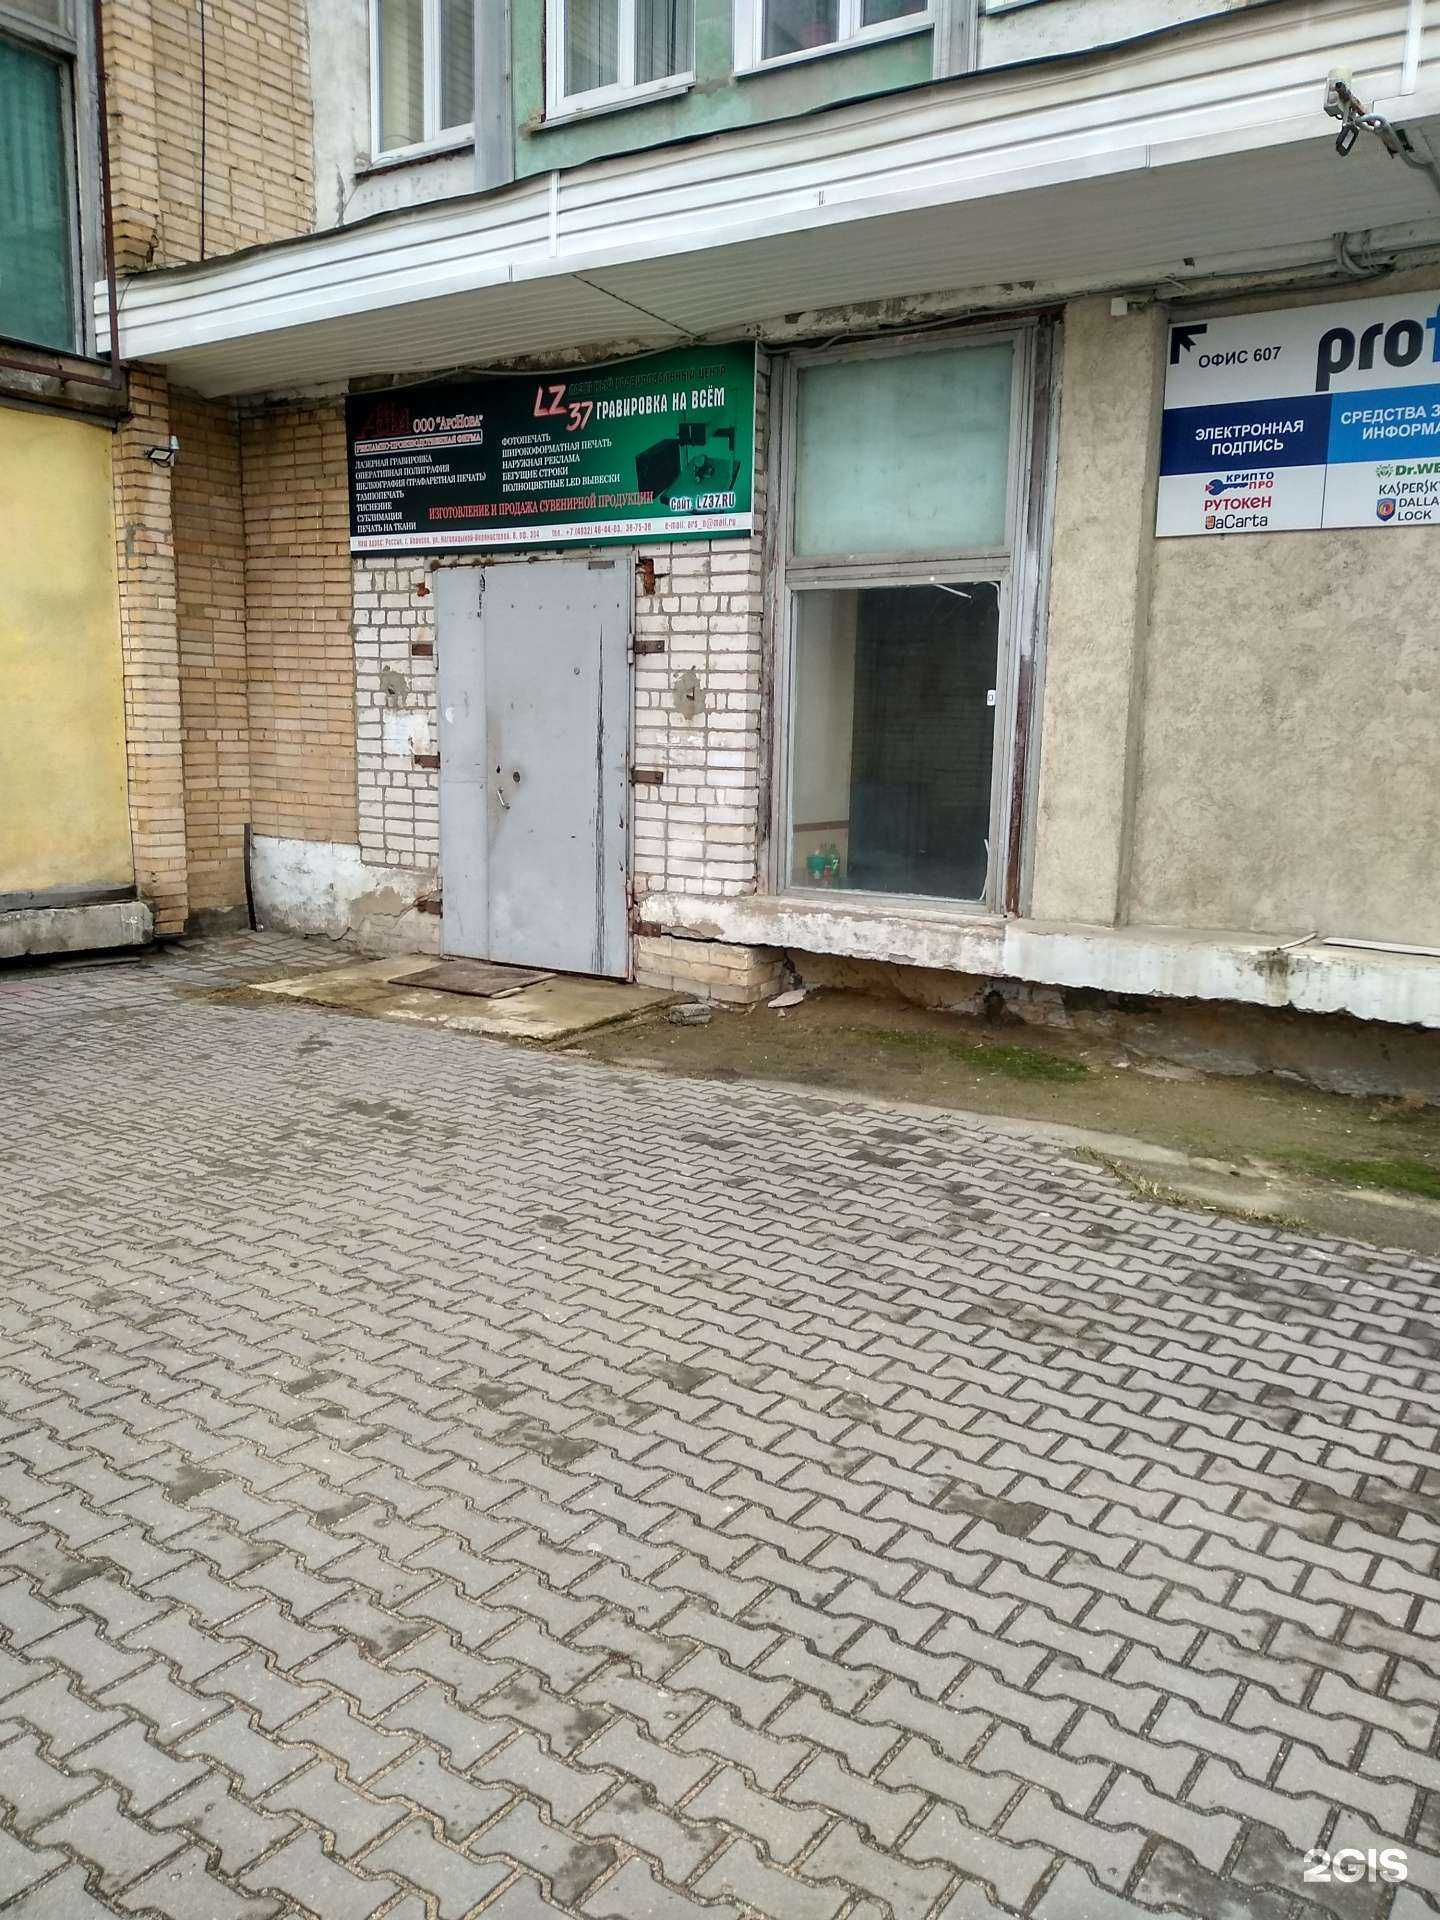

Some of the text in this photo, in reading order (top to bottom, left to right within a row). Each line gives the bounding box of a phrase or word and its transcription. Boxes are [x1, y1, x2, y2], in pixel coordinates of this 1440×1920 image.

[1198, 346, 1282, 369] ОФИС 607
[533, 384, 593, 431] LZ 37
[597, 385, 725, 420] ГРАВИРОВКА НА ВСЁМ
[1340, 405, 1427, 425] СРЕДСТВА
[413, 417, 435, 433] ООО
[1195, 420, 1304, 442] ЭЛЕКТРОННАЯ
[501, 433, 551, 446] ФОТОПЕЧАТЬ
[1211, 438, 1284, 456] ПОДПИСЬ
[502, 438, 612, 458] ШИРОКОФОРМАТНАЯ ПЕЧАТЬ
[355, 455, 432, 469] ЛАЗЕРНАЯ ГРАВИРОВКА
[502, 454, 580, 469] НАРУЖНАЯ РЕКЛАМА
[355, 464, 450, 480] ОПЕРАТИВНАЯ ПОЛИГРАФИЯ
[502, 466, 568, 481] БЕГУЩИЕ СТРОКИ
[1225, 471, 1274, 483] КРИПТО
[356, 471, 487, 490] ШЕЛКОГРАФИЯ (ТРАФАРЕТНАЯ ПЕЧАТЬ)
[502, 473, 620, 493] ПОЛНОЦВЕТНЫЕ LED ВЫВЕСКИ
[1249, 480, 1274, 490] ПРО
[1379, 479, 1440, 496] KASPERSK
[356, 490, 404, 501] ТАМПОПЕЧАТЬ
[696, 491, 735, 510] LZ37.RU
[356, 502, 392, 512] ТИСНЕНИЕ
[429, 491, 653, 520] ИЗГОТОВЛЕНИЕ И ПРОДАЖА СУВЕНИРНОЙ ПРОДУКЦИИ
[356, 511, 402, 522] СУБЛИМАЦИЯ
[1397, 510, 1432, 521] LOCK
[357, 522, 416, 533] ПЕЧАТЬ НА ТКАНИ
